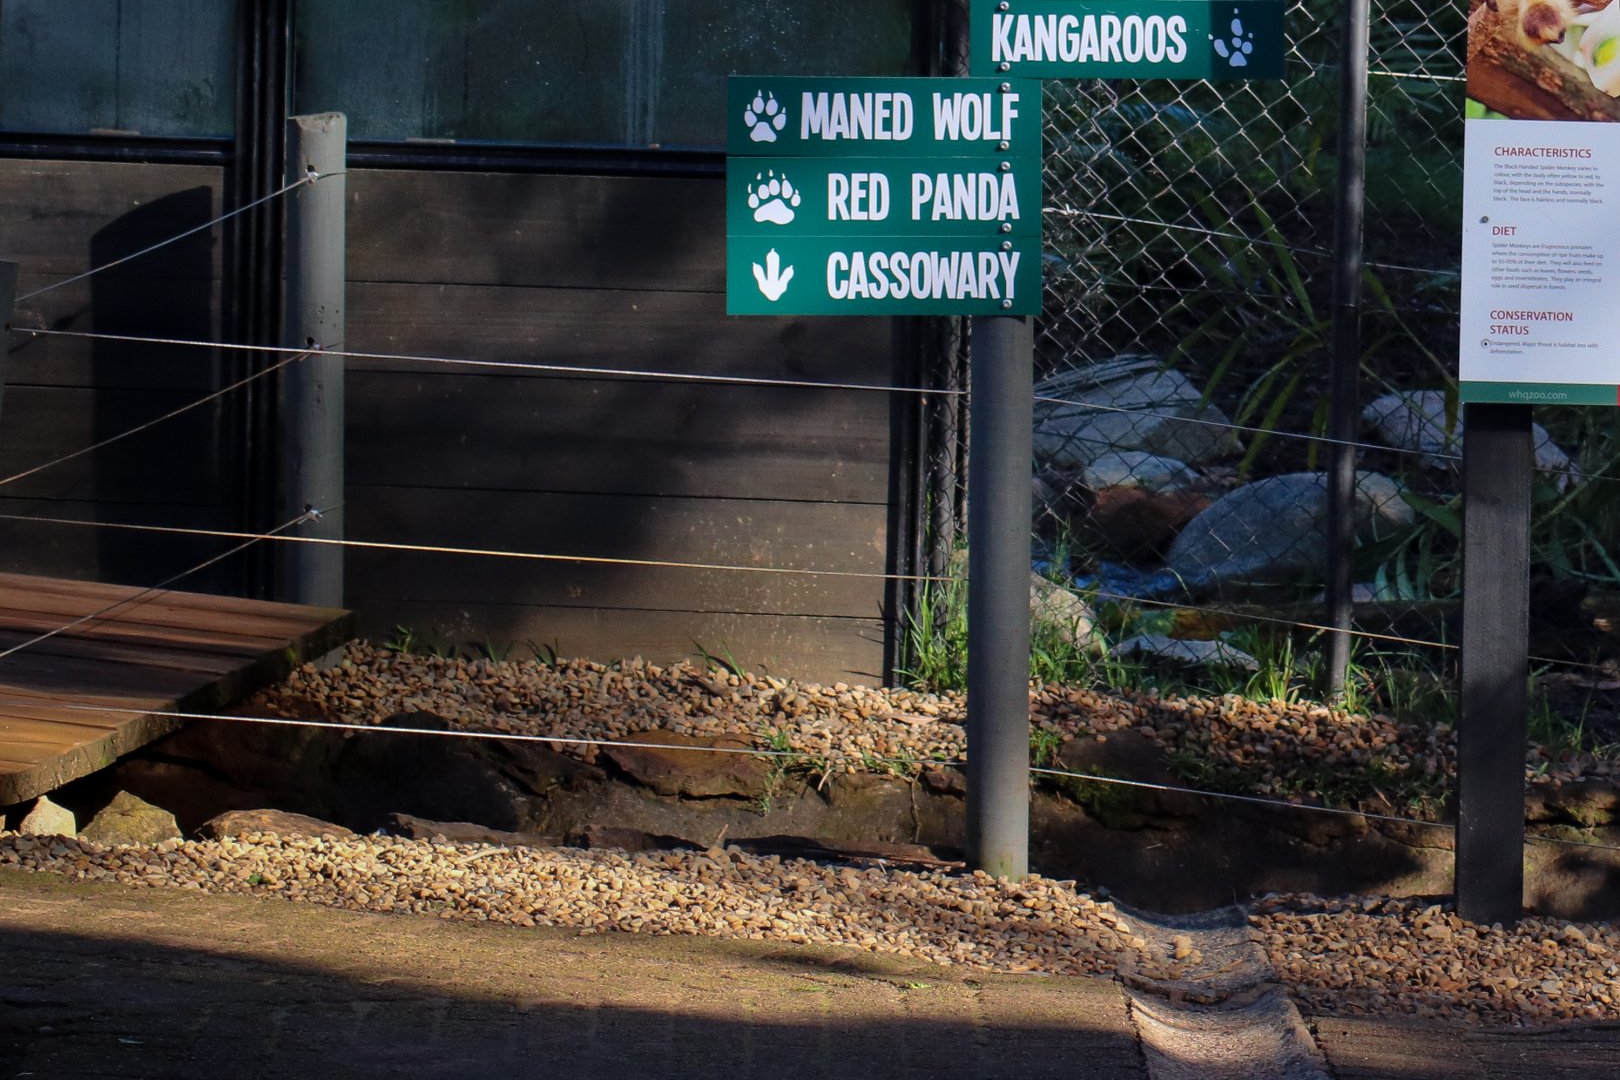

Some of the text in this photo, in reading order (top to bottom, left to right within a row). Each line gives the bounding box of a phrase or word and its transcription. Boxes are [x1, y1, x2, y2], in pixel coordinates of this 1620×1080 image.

[992, 14, 1187, 63] KANGAROOS
[801, 92, 1019, 140] MANED WOLF
[1495, 147, 1591, 158] CHARACTERISTICS
[828, 173, 1020, 221] RED PANDA
[1492, 226, 1516, 235] DIET
[827, 252, 1020, 300] CASSOWARY
[1490, 310, 1573, 321] CONSERVATION
[1490, 325, 1529, 335] STATUS
[1509, 390, 1567, 401] whqzoo.com
